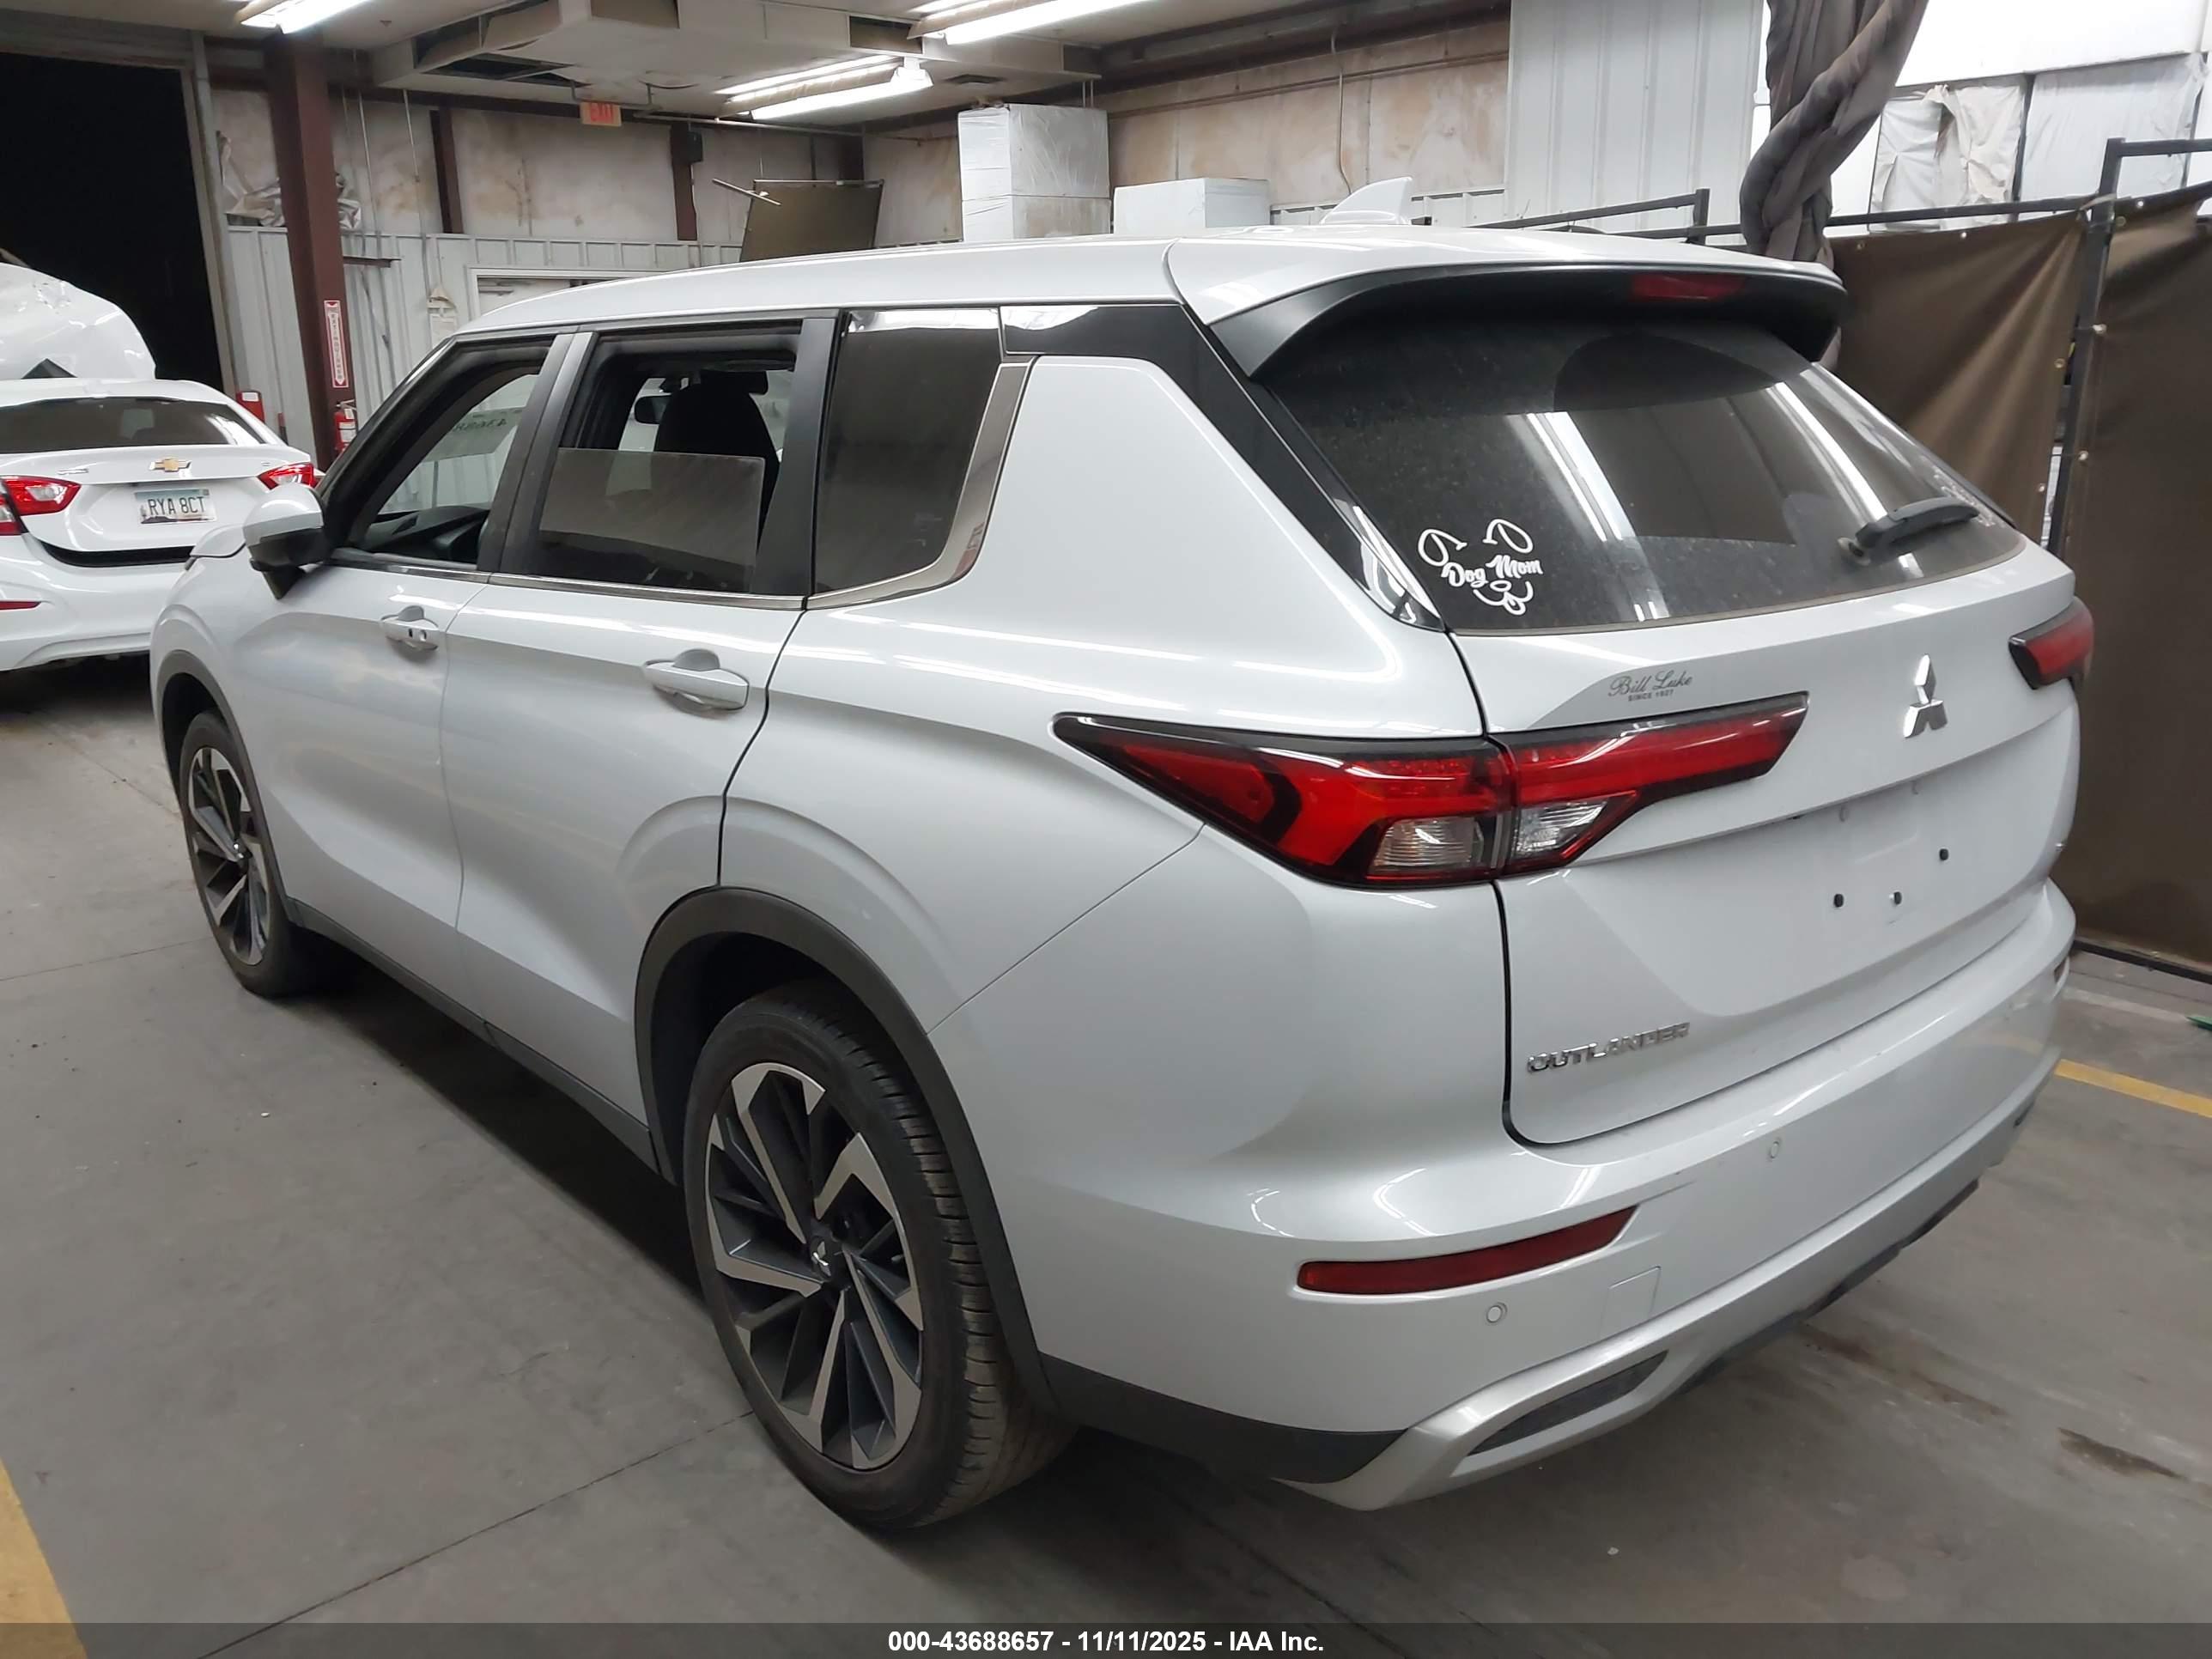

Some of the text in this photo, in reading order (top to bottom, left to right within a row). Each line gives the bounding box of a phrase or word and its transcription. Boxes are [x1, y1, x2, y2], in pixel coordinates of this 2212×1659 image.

[148, 495, 205, 516] RYA 8CT
[1441, 555, 1544, 588] Dog Mom
[1607, 670, 1693, 697] Bill Luke
[1527, 1021, 1691, 1074] OUTLANDER
